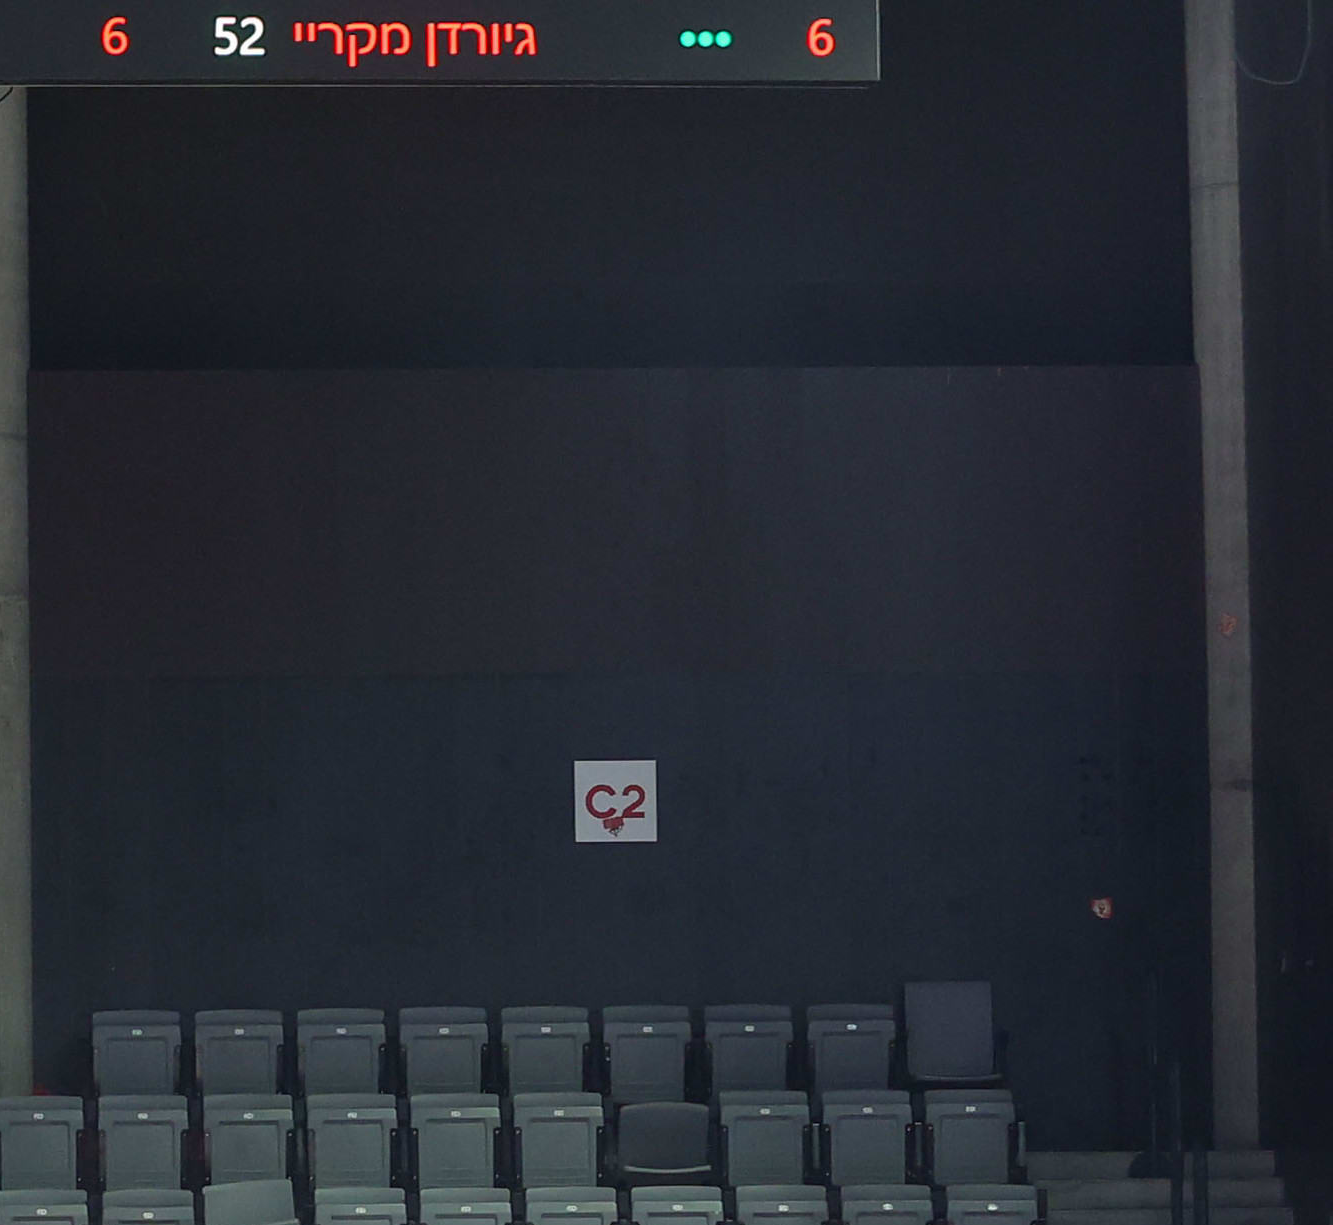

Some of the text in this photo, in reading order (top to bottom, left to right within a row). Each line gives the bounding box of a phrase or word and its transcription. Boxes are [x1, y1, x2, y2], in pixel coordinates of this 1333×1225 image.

[102, 17, 130, 56] 6
[214, 17, 836, 69] 52 גיורדן מקריי 6
[585, 784, 646, 819] C2
